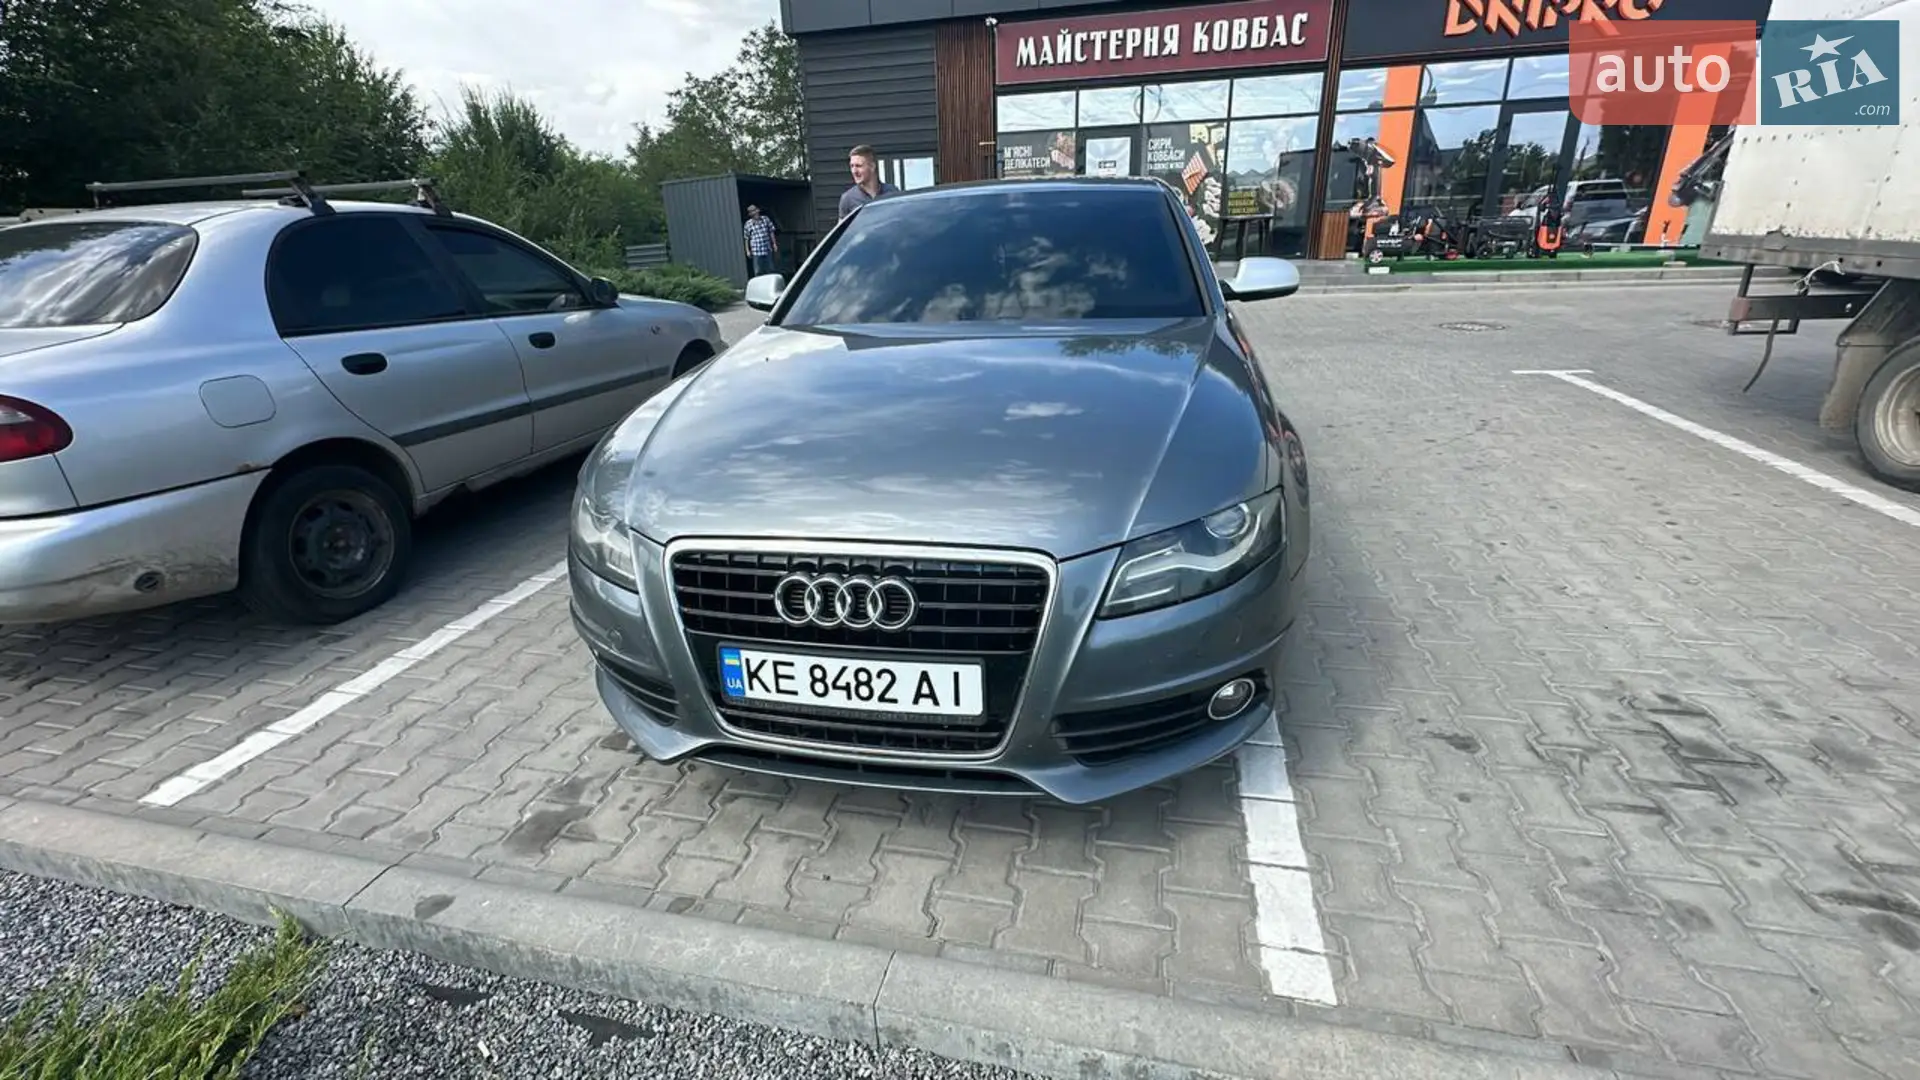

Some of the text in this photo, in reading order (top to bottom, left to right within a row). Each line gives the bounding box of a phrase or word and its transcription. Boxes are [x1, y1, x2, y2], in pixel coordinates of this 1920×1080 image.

[1016, 12, 1308, 67] МАЙСТЕРНЯ КОВБАС
[727, 678, 743, 689] UA
[745, 658, 798, 695] KE
[809, 664, 898, 704] 8482
